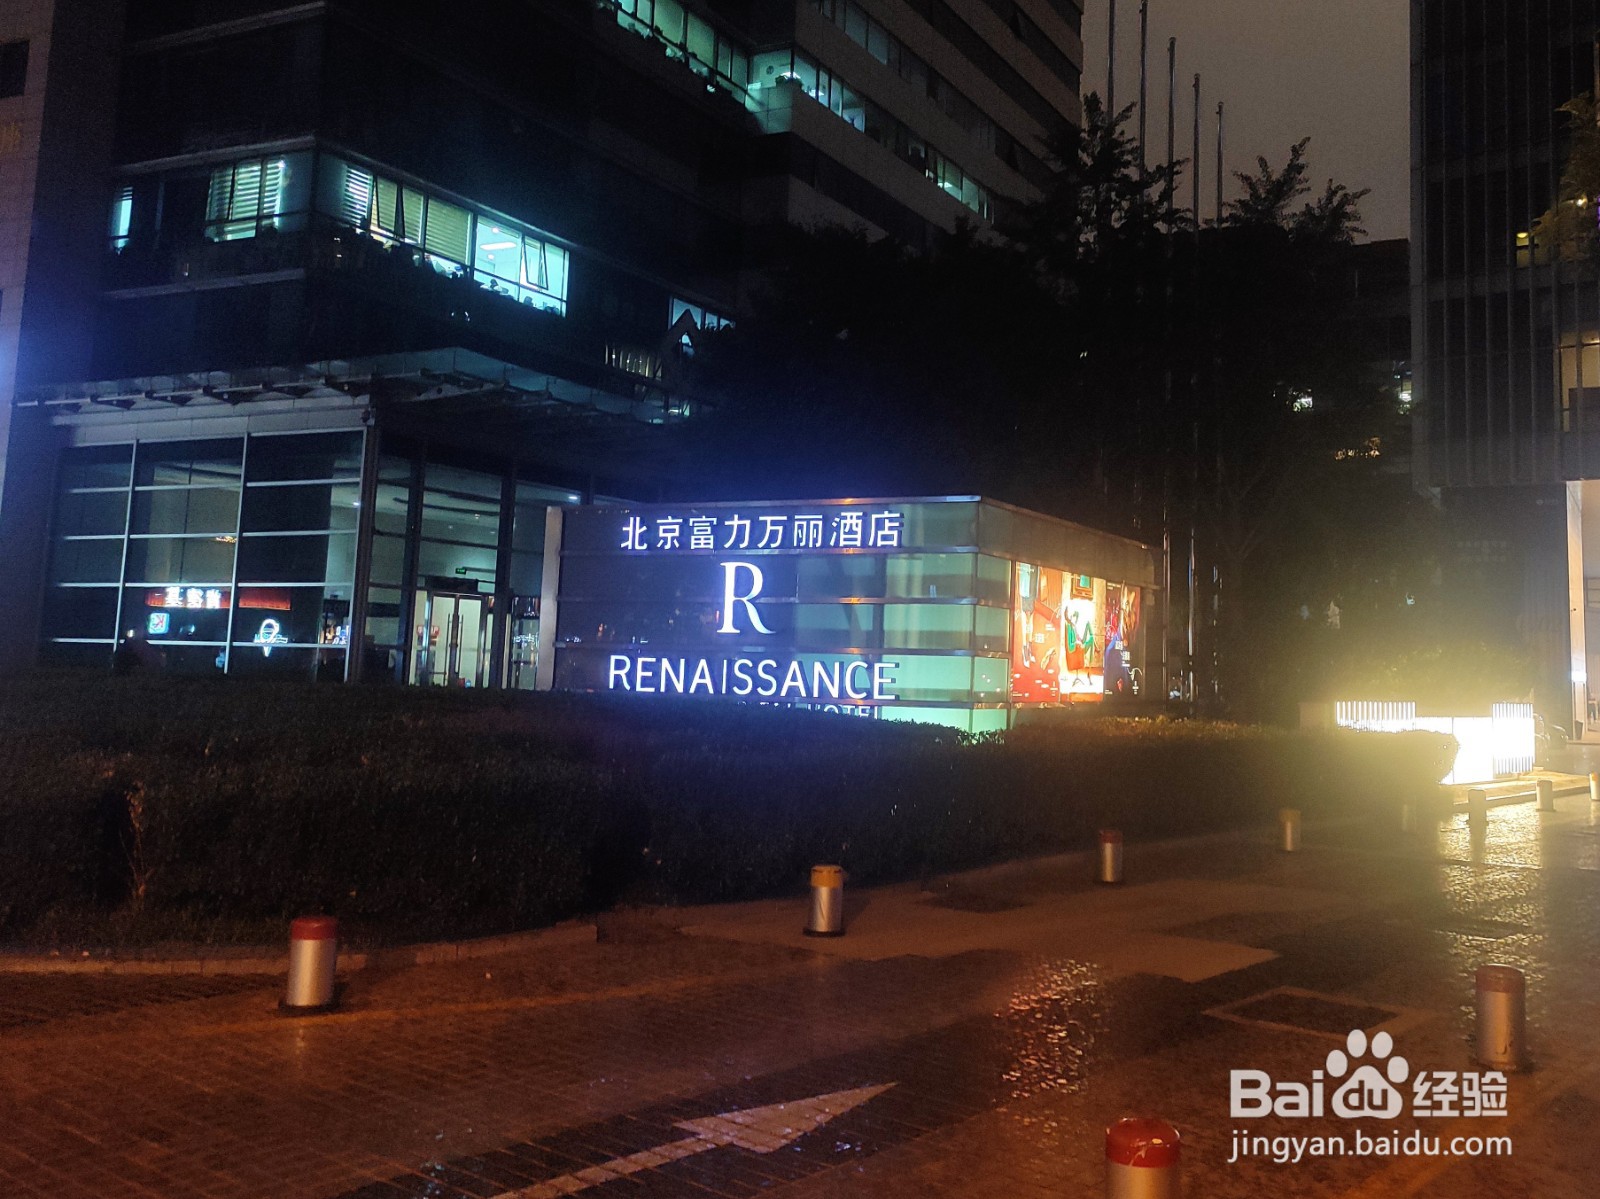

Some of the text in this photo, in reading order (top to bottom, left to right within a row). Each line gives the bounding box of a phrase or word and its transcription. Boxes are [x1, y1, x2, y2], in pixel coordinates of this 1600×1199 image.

[620, 510, 903, 550] 北京富力万丽酒店
[716, 561, 776, 635] R
[608, 654, 899, 701] RENAISSANCE
